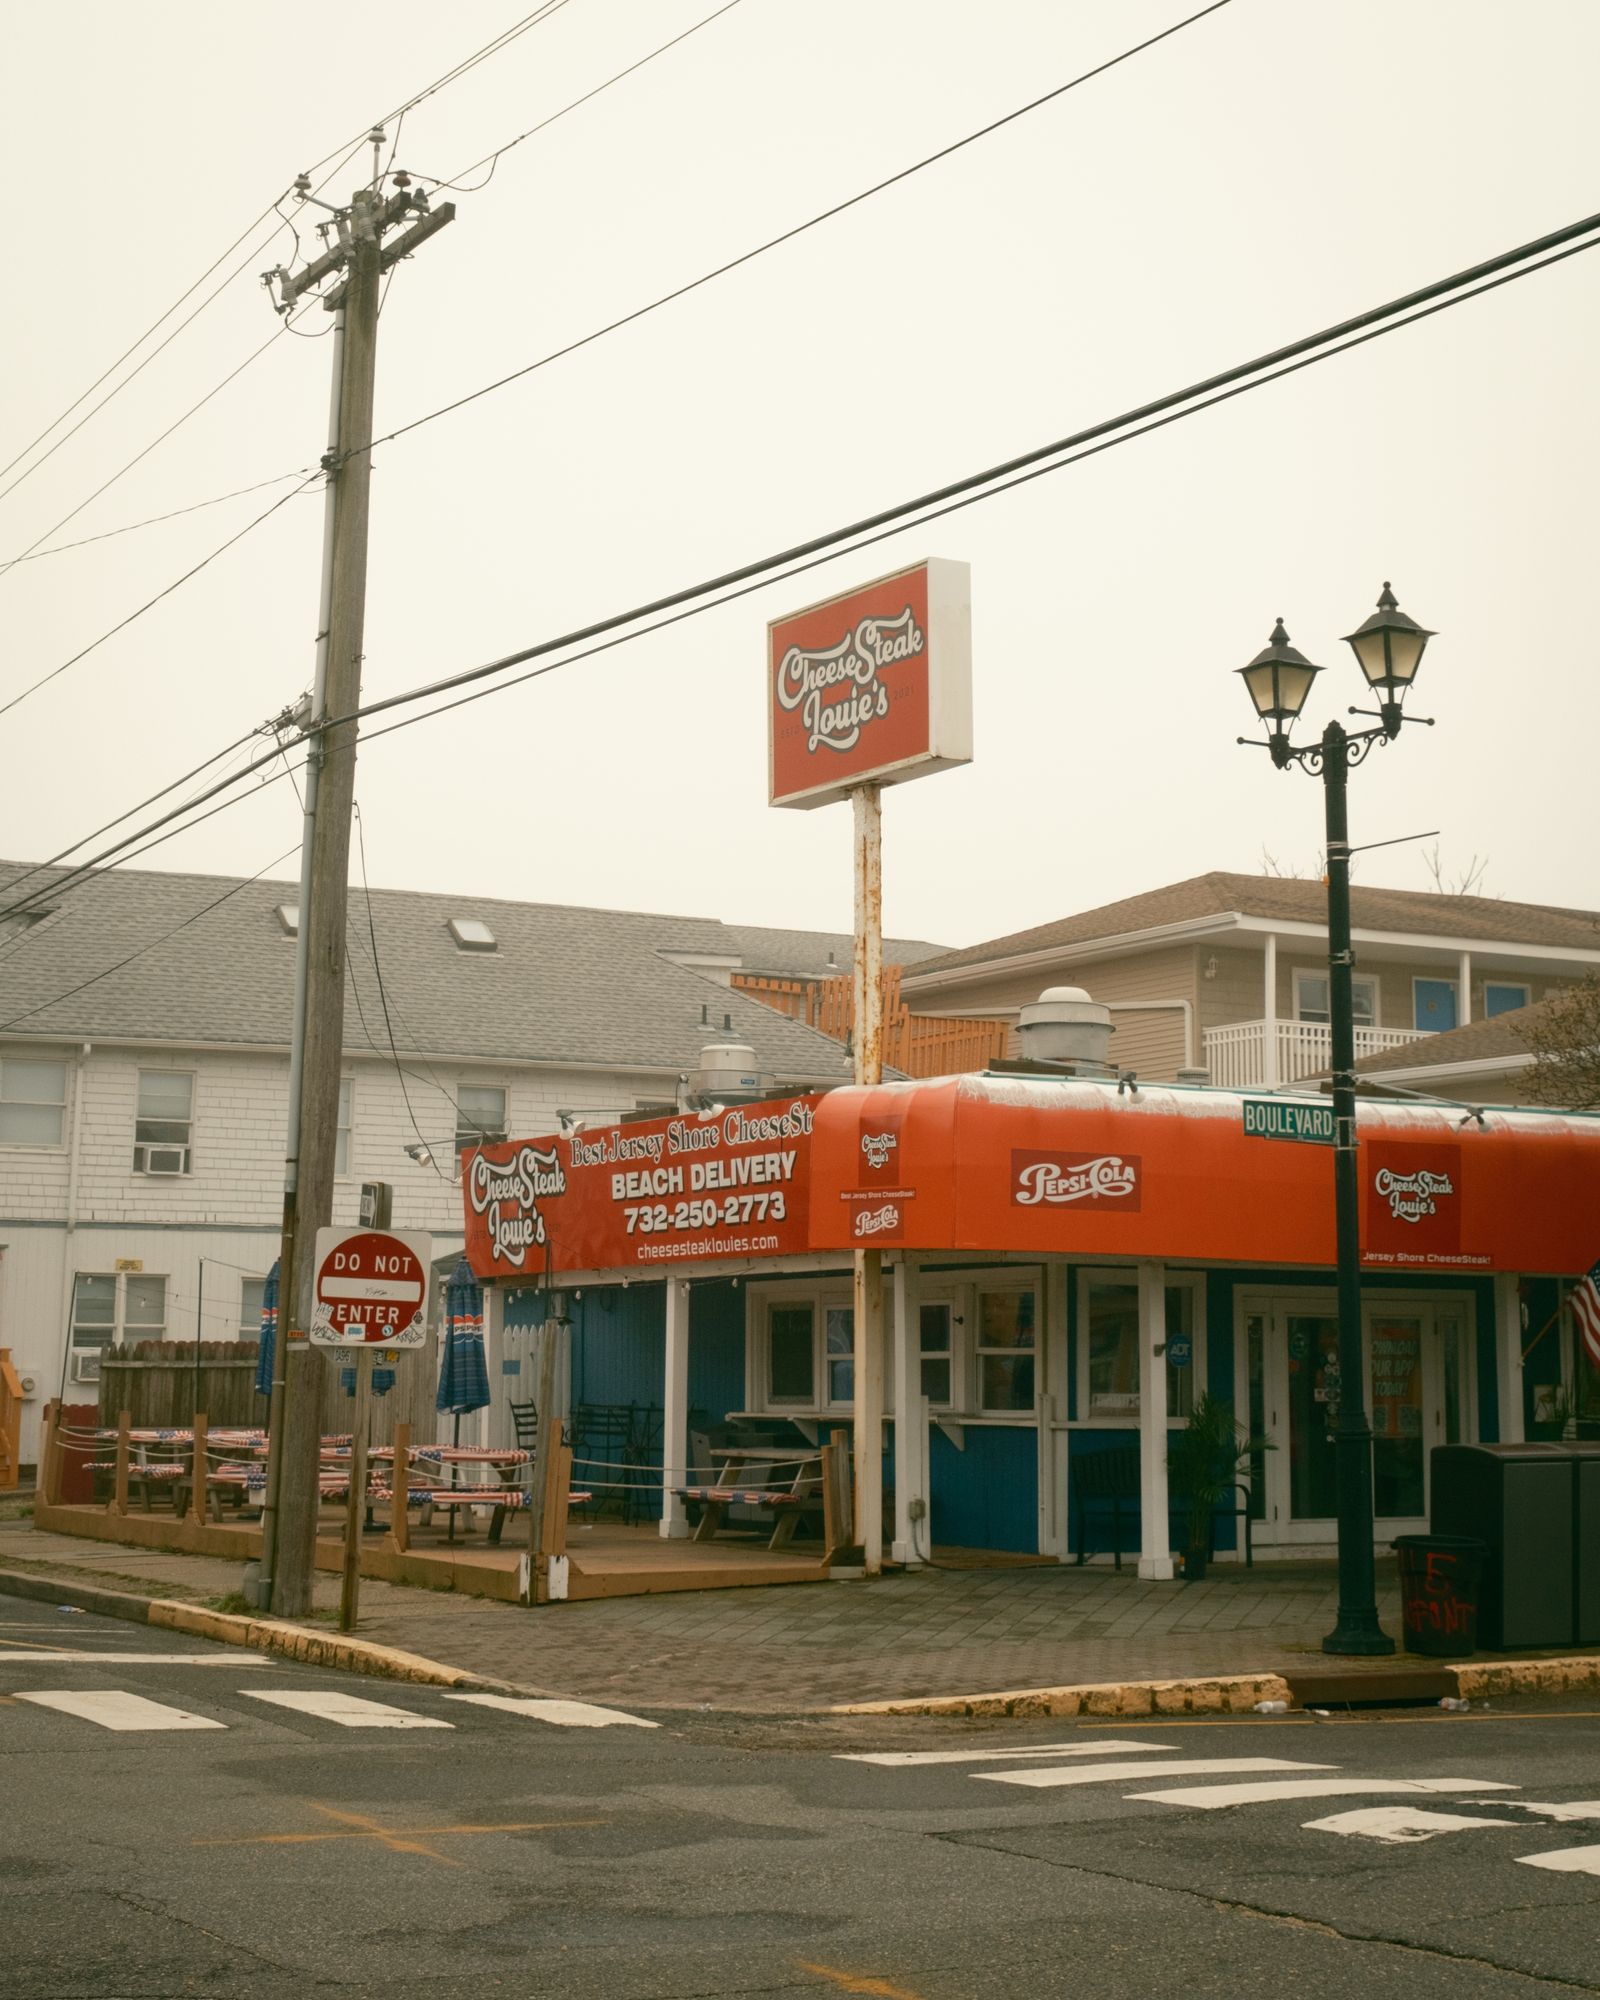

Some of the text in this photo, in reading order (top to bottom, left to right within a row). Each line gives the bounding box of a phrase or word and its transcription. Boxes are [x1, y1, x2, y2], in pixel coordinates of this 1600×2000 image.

[803, 678, 888, 752] Louie's
[570, 1101, 815, 1167] Best Jersey Shore CheeseSt
[1245, 1104, 1333, 1136] BOULEVARD
[470, 1147, 566, 1213] CheeseSteak
[611, 1150, 797, 1200] BEACH DELIVERY
[624, 1191, 787, 1234] 732-250-2773
[1389, 1191, 1436, 1223] Louie's
[488, 1200, 546, 1266] Louie's
[637, 1235, 779, 1259] cheesesteaklouies.com
[334, 1253, 412, 1274] DO NOT
[1363, 1252, 1491, 1265] Jersey Shore CheeseSteak!
[336, 1304, 400, 1324] ENTER
[1170, 1343, 1190, 1356] ADT
